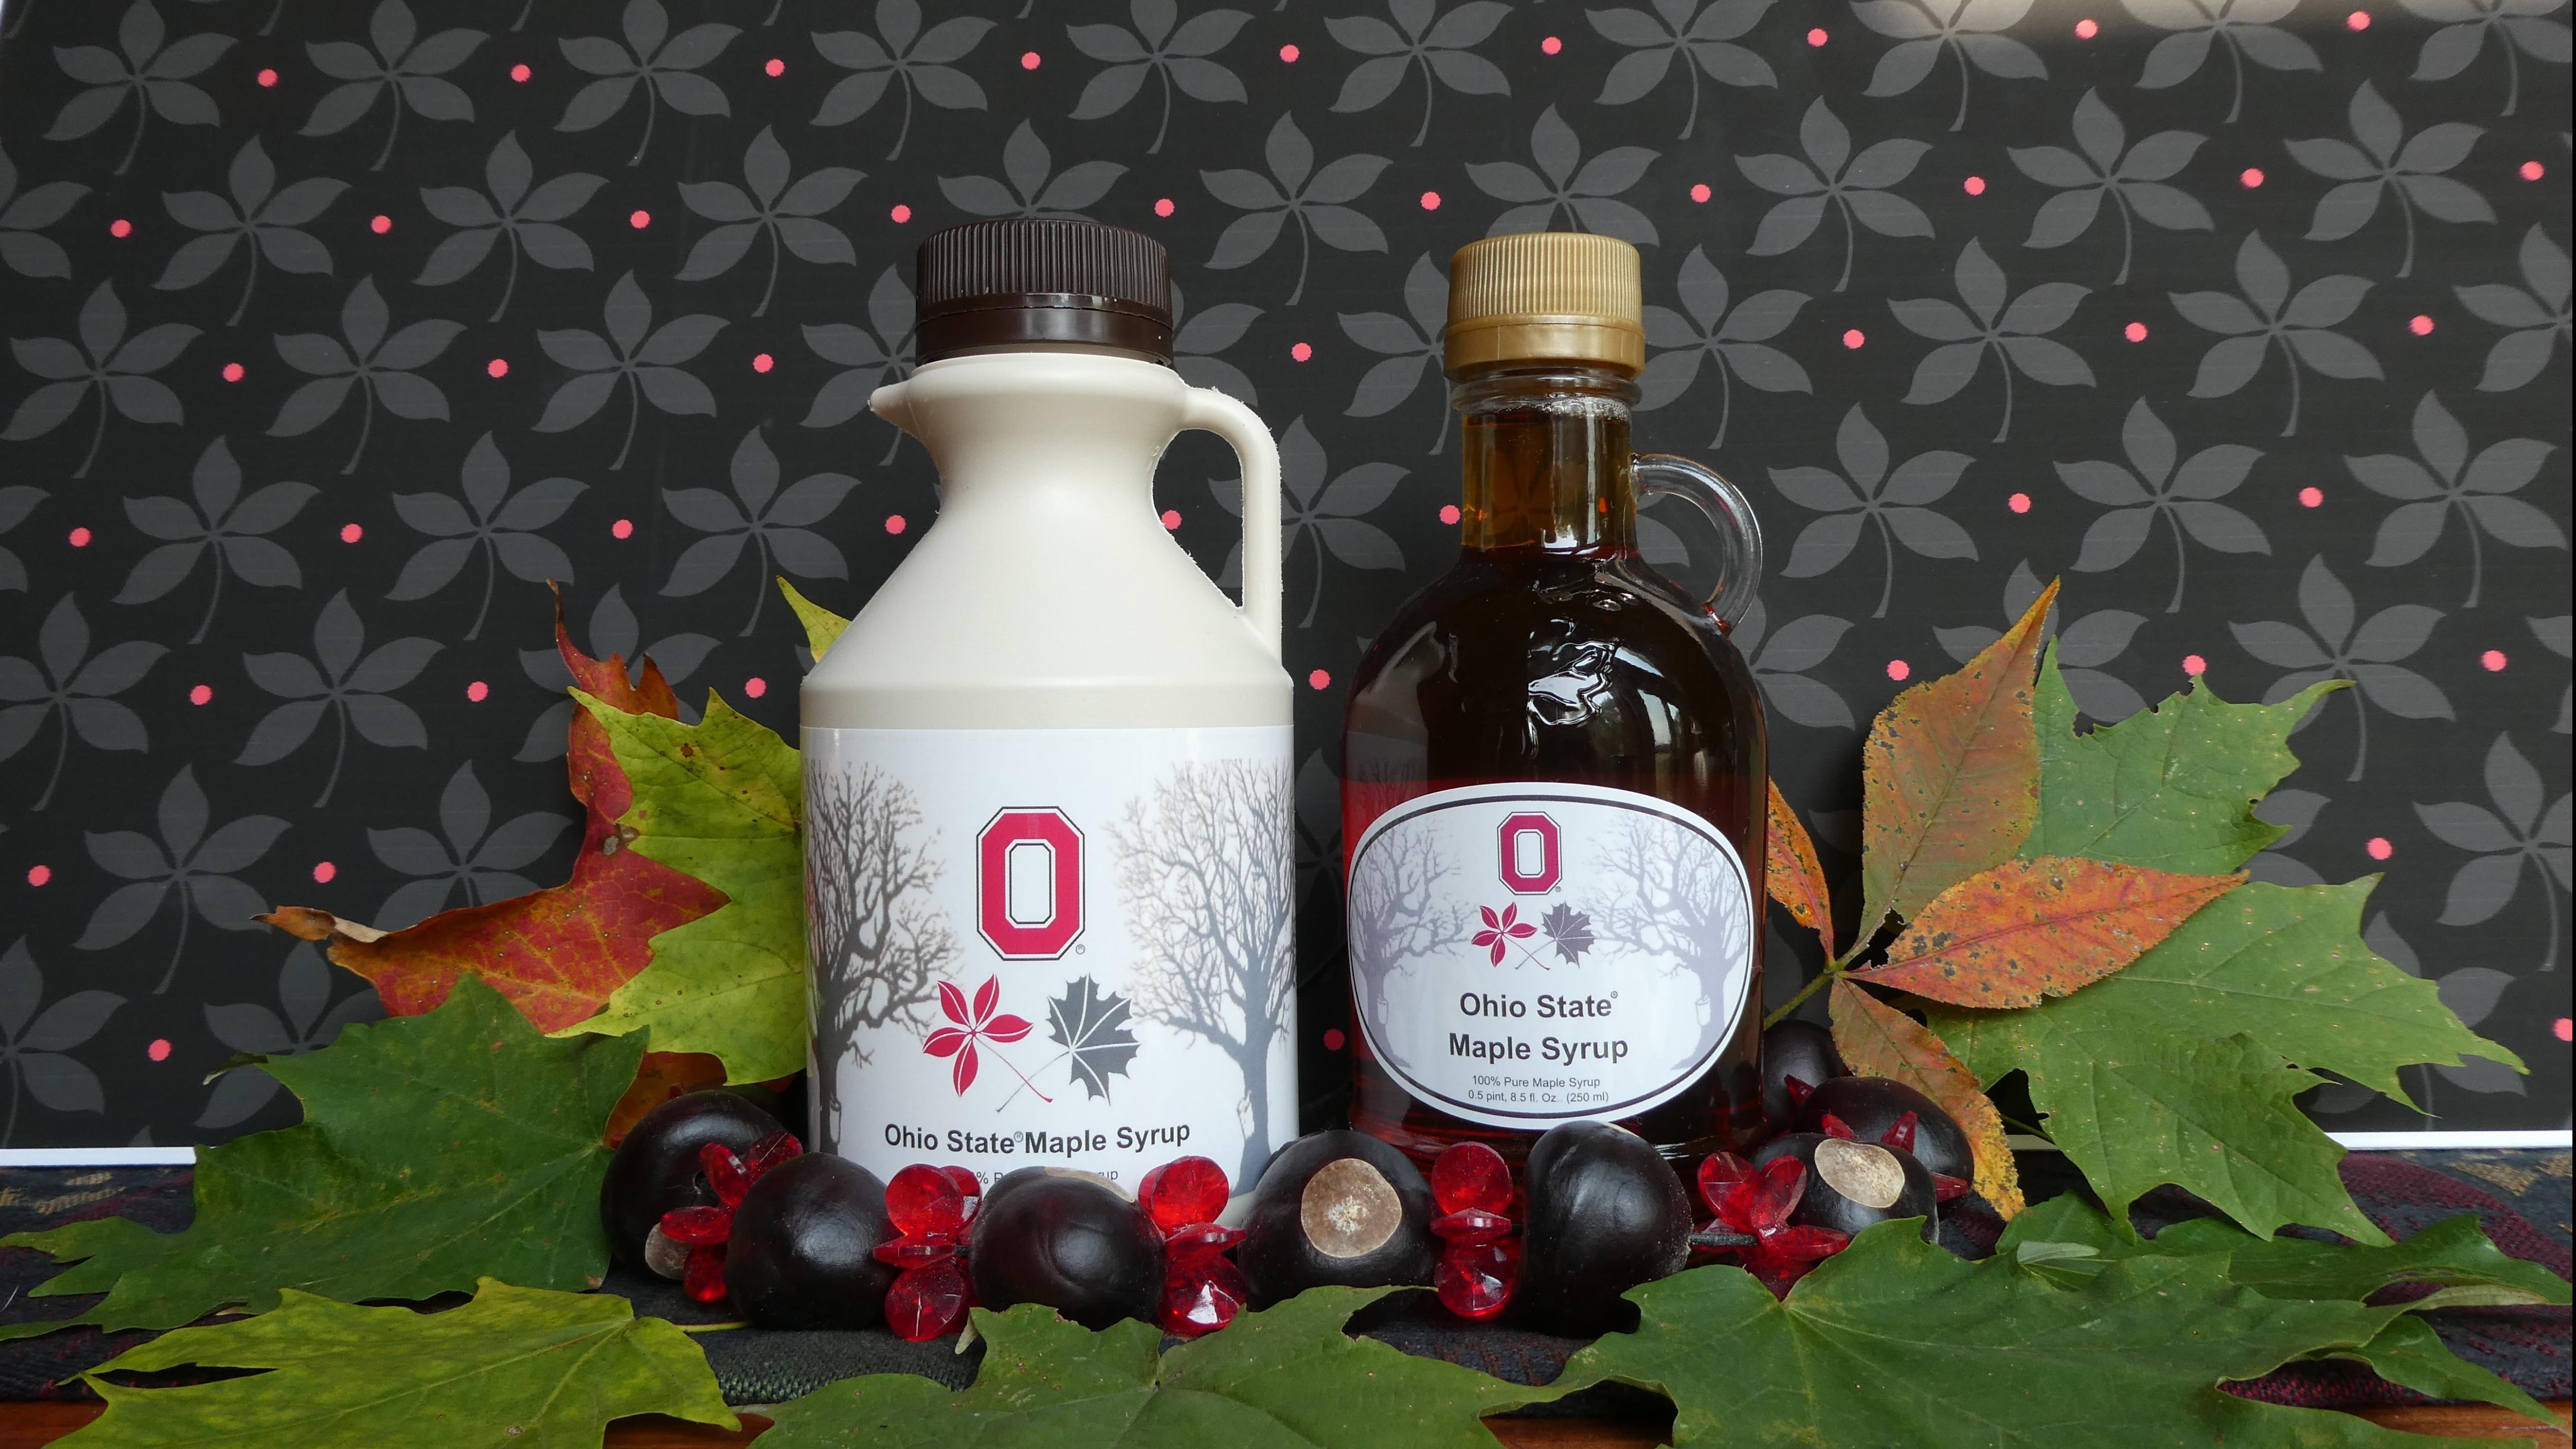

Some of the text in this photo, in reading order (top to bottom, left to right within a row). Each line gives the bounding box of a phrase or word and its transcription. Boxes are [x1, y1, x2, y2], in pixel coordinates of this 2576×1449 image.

[1460, 992, 1526, 1018] Ohio
[1449, 1032, 1628, 1066] Maple Syrup
[1472, 1075, 1601, 1089] 100% Pure Maple Syrup
[1468, 1089, 1483, 1100] 0.5
[1486, 1090, 1507, 1102] pint,
[1510, 1093, 1526, 1102] 8.5
[1566, 1092, 1590, 1105] (250
[1593, 1091, 1609, 1103] ml)
[884, 1123, 938, 1151] Ohio
[1025, 1130, 1107, 1158] Maple
[1116, 1124, 1190, 1153] Syrup
